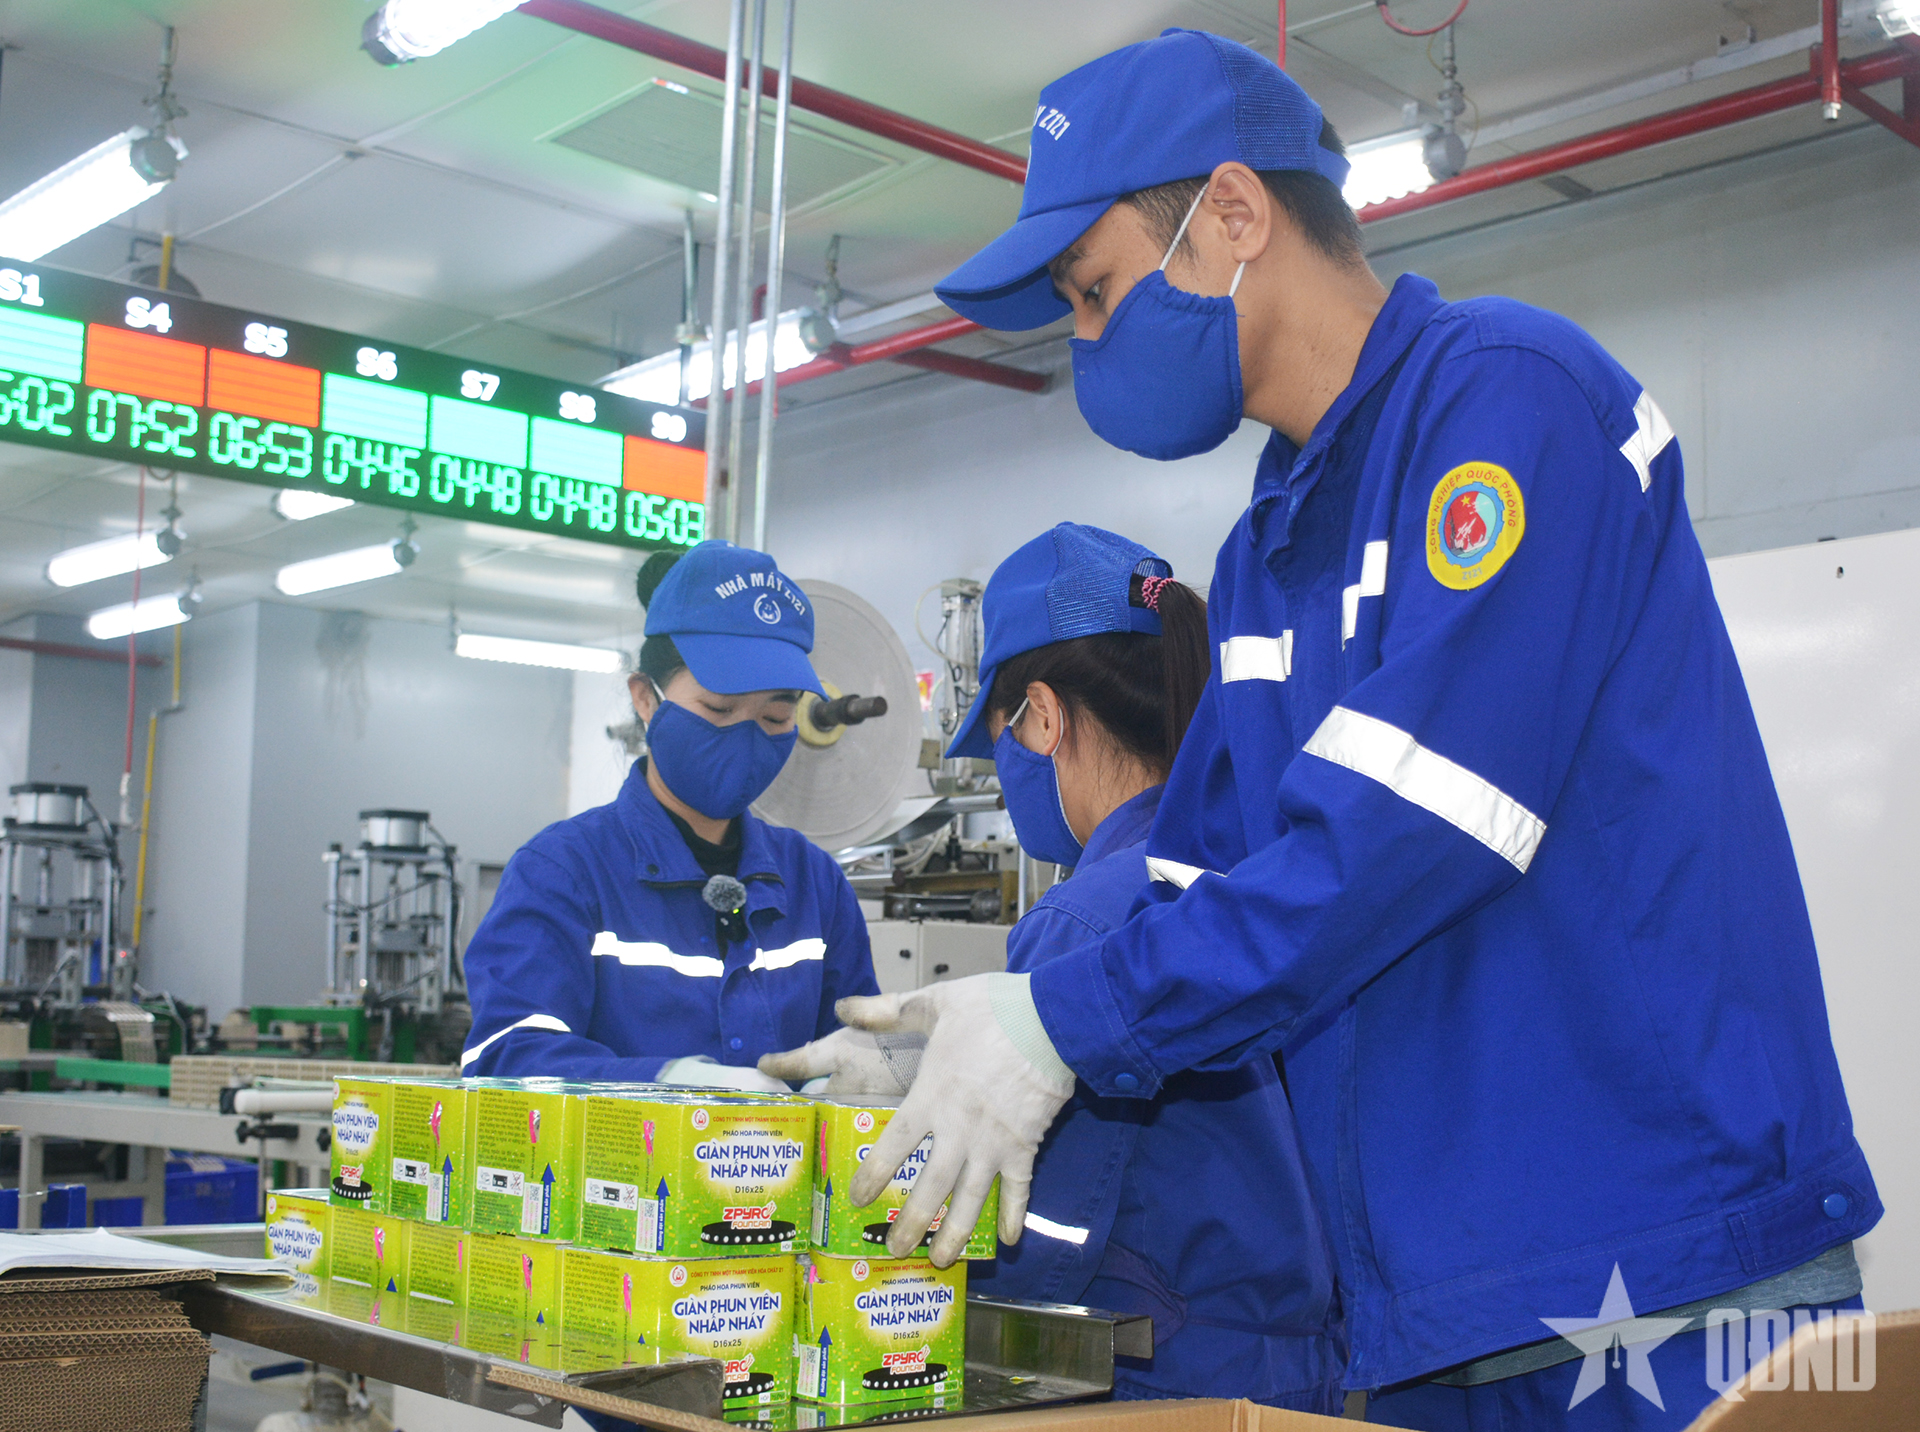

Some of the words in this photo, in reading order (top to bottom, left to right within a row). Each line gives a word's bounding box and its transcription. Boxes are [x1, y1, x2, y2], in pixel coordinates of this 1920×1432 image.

[1038, 108, 1071, 141] Z121
[0, 268, 44, 307] S1
[125, 296, 172, 333] S4
[243, 322, 289, 358] S5
[356, 346, 398, 381] S6
[460, 369, 500, 401] S7
[86, 388, 199, 459] 07:52
[208, 411, 314, 478] 06:53
[1461, 567, 1483, 581] Z121
[714, 574, 749, 599] NHÀ
[750, 571, 783, 592] MÁY
[784, 587, 806, 616] Z121
[769, 1129, 783, 1137] VIÊN
[696, 1142, 730, 1160] GIÀN
[733, 1145, 766, 1159] PHUN
[772, 1142, 802, 1159] VIÊN
[711, 1159, 748, 1178] NHẤP
[751, 1161, 788, 1178] NHÁY
[735, 1186, 764, 1194] D16x25
[674, 1297, 707, 1316] GIÀN
[710, 1298, 747, 1313] PHUN
[750, 1293, 779, 1310] VIÊN
[856, 1292, 889, 1309] GIÀN
[891, 1291, 925, 1307] PHUN
[927, 1286, 953, 1304] VIÊN
[689, 1313, 726, 1334] NHẤP
[728, 1312, 766, 1331] NHÁY
[870, 1306, 906, 1326] NHẤP
[907, 1305, 941, 1324] NHÁY
[713, 1339, 742, 1348] D16x25
[893, 1330, 920, 1340] D16x25
